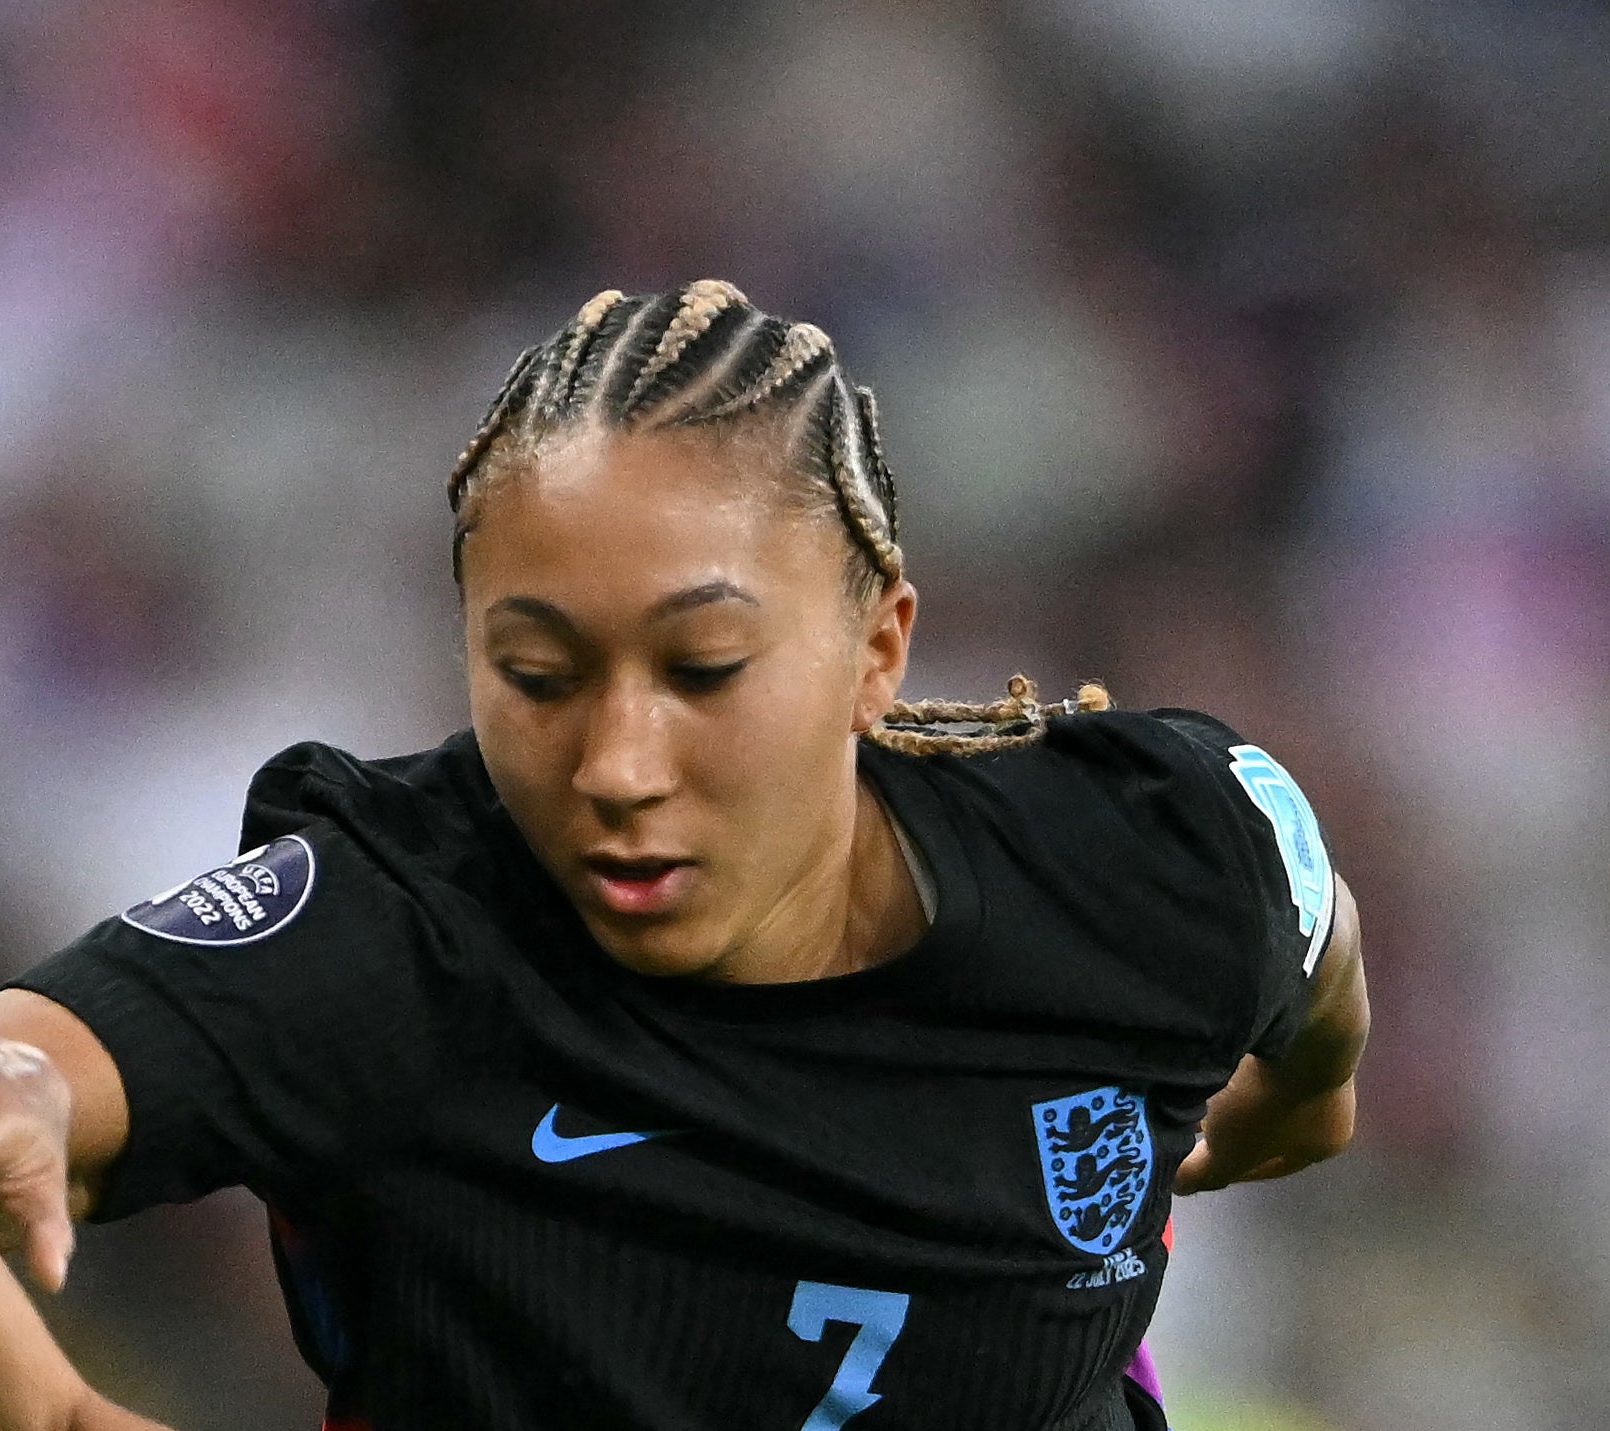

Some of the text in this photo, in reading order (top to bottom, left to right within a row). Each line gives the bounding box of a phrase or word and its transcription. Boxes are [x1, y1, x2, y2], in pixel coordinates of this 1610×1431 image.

[211, 870, 268, 921] EUROPEAN
[241, 864, 275, 896] UEFA
[179, 890, 223, 926] 2022
[193, 877, 254, 931] CHAMPIONS
